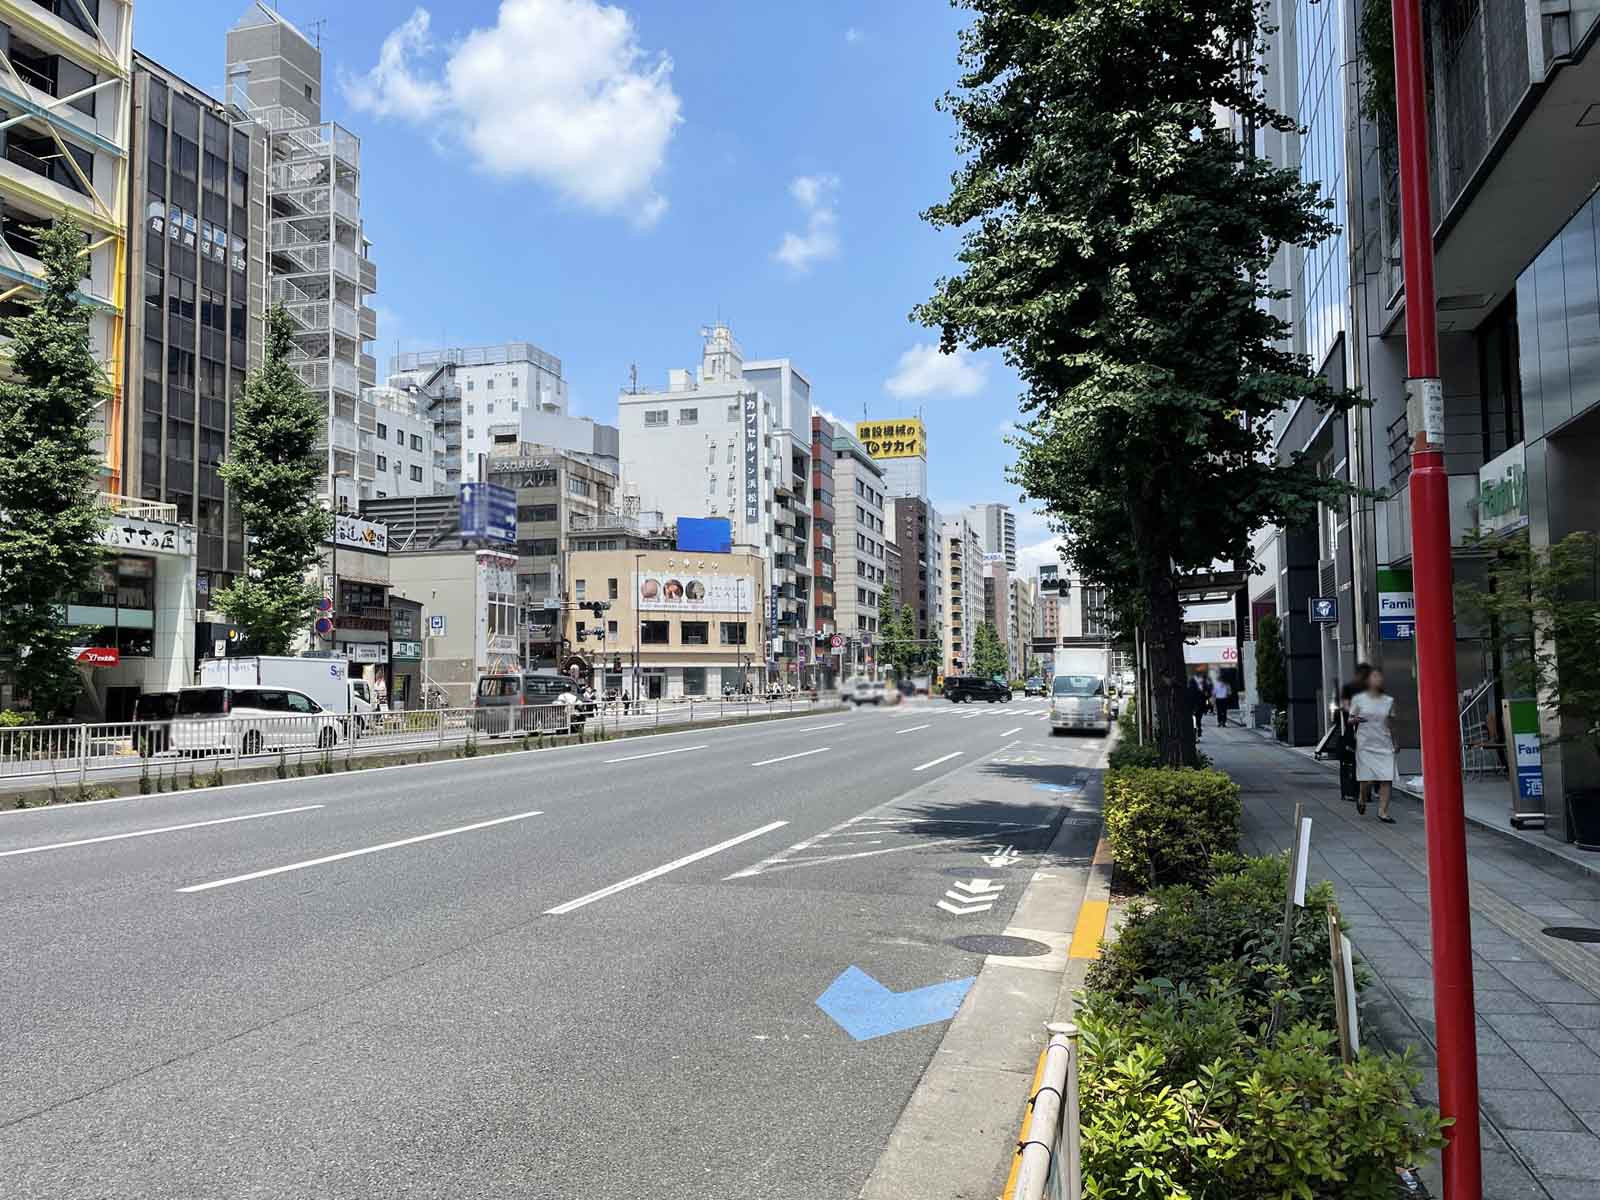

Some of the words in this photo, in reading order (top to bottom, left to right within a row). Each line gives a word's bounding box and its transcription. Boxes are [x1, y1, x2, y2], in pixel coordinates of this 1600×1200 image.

[861, 425, 915, 438] 建設機械の
[881, 440, 917, 454] サカイ
